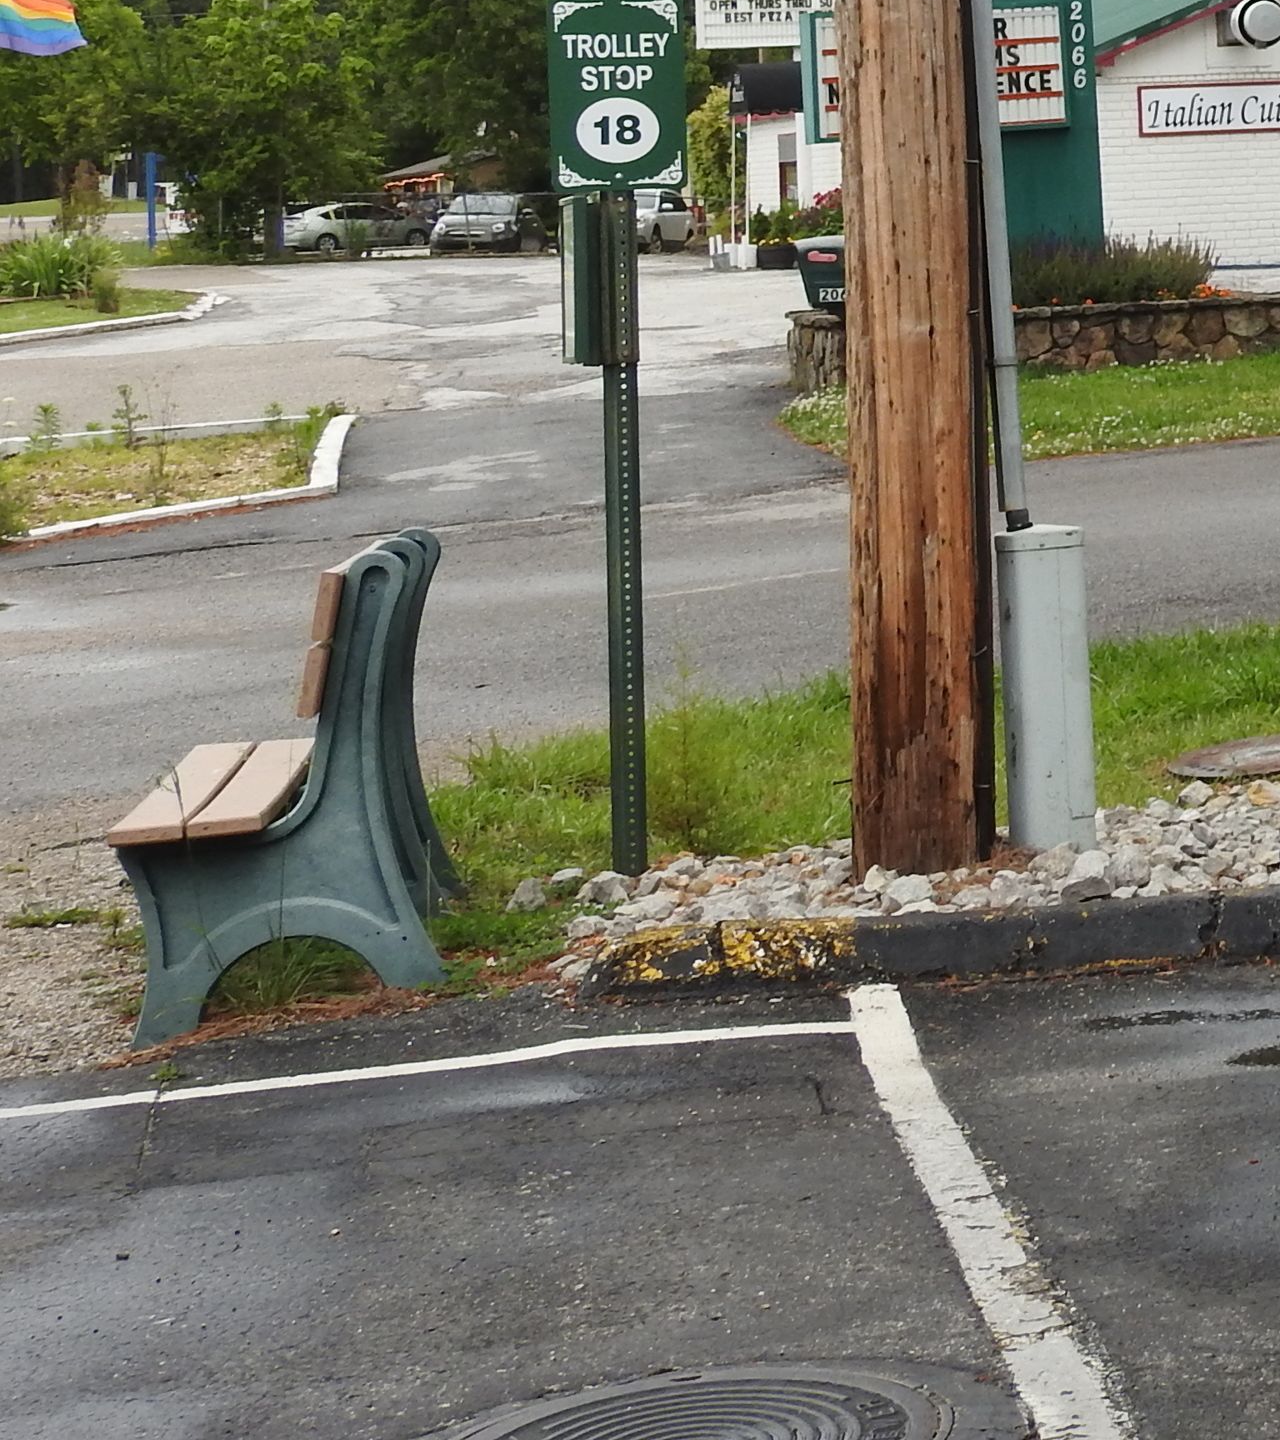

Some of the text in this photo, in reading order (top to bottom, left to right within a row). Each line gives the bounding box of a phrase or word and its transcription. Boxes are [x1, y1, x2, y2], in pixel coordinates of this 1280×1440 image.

[709, 0, 738, 11] OPEN
[724, 11, 753, 23] BEST
[561, 32, 670, 60] TROLLEY
[1069, 0, 1087, 89] 2066
[580, 64, 654, 92] STOP
[996, 70, 1052, 94] ENCE
[1147, 93, 1235, 129] Italian
[593, 113, 642, 146] 18
